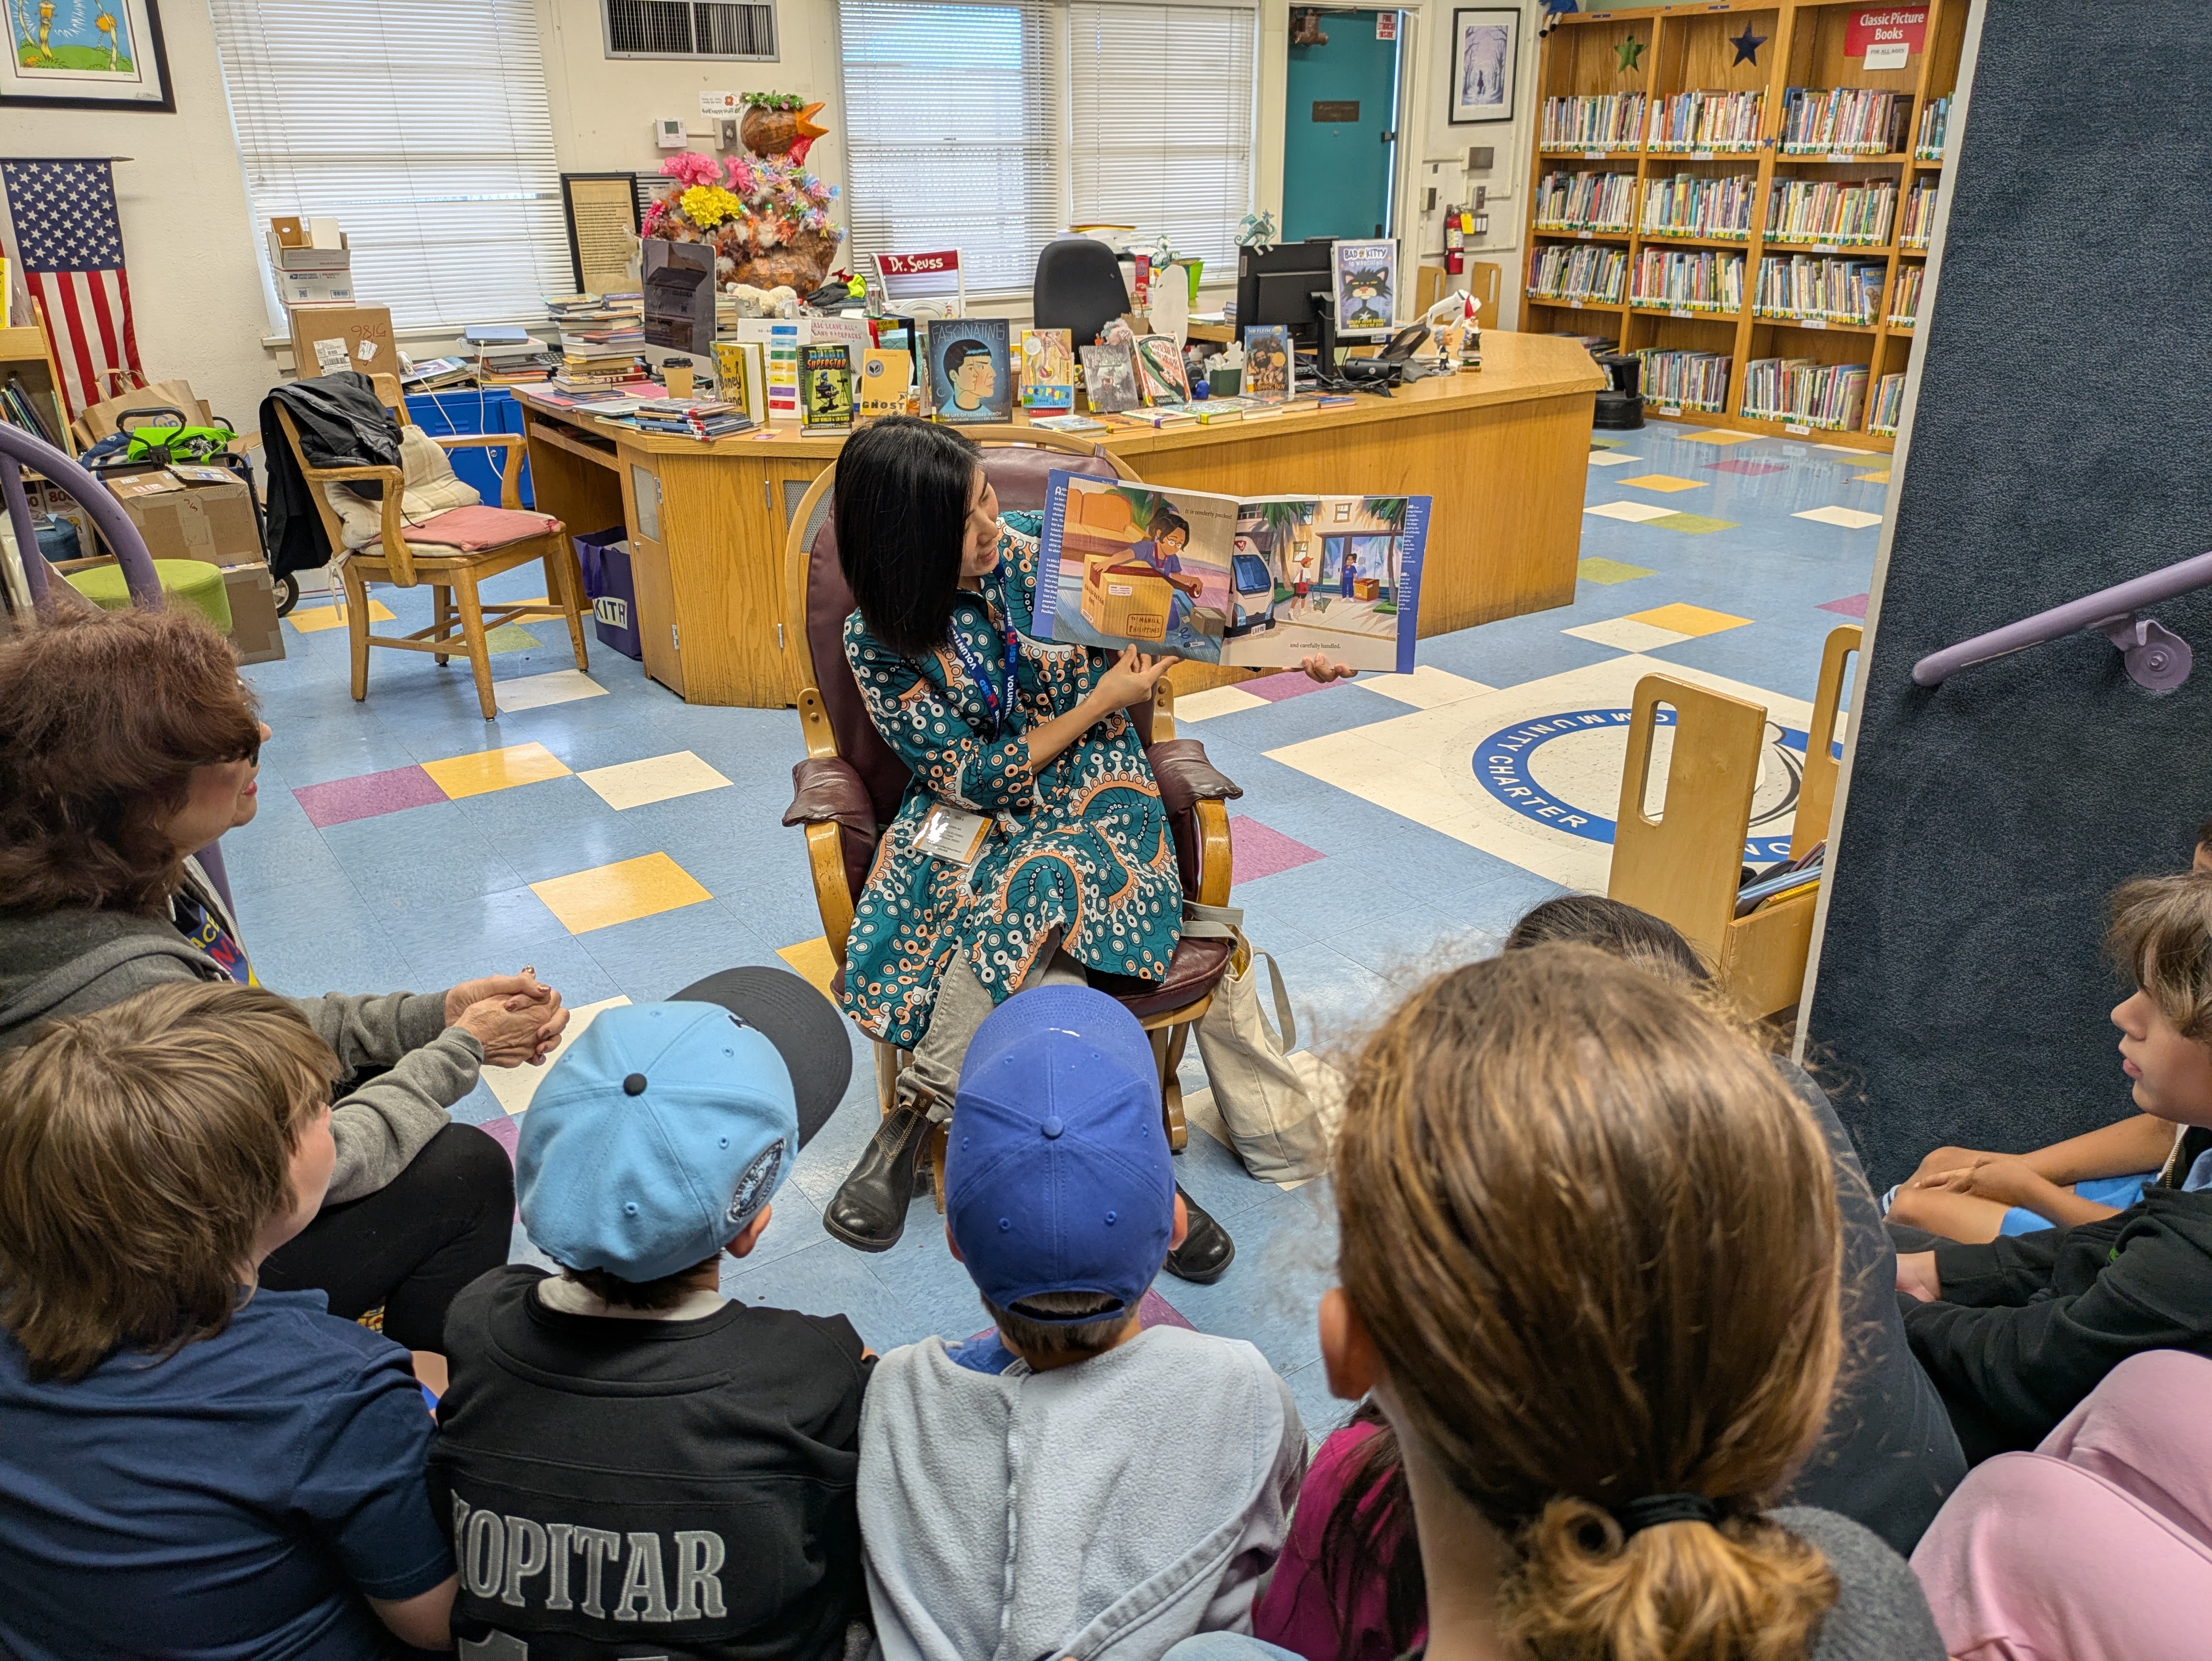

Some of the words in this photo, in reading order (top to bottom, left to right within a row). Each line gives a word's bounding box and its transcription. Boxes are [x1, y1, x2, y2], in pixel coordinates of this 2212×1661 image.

[1860, 13, 1890, 26] Classic
[1891, 12, 1924, 24] Picture
[1875, 27, 1903, 40] Books
[1344, 249, 1358, 259] BAD
[1366, 248, 1386, 258] KITTY
[888, 256, 907, 272] Dr.
[907, 255, 943, 272] Seuss
[931, 322, 1005, 344] FASCINATING
[808, 349, 845, 359] ALIEN
[723, 364, 732, 374] The
[807, 358, 847, 370] SUPERSTAR
[719, 373, 741, 391] Boney
[721, 390, 742, 407] Hand
[862, 401, 905, 410] GHOST
[1195, 510, 1215, 518] tenderly
[1084, 583, 1105, 606] BALIKBAYAN
[595, 599, 625, 624] KITH
[1129, 625, 1160, 634] PHILIPPINES
[1489, 755, 1588, 828] CHARTER
